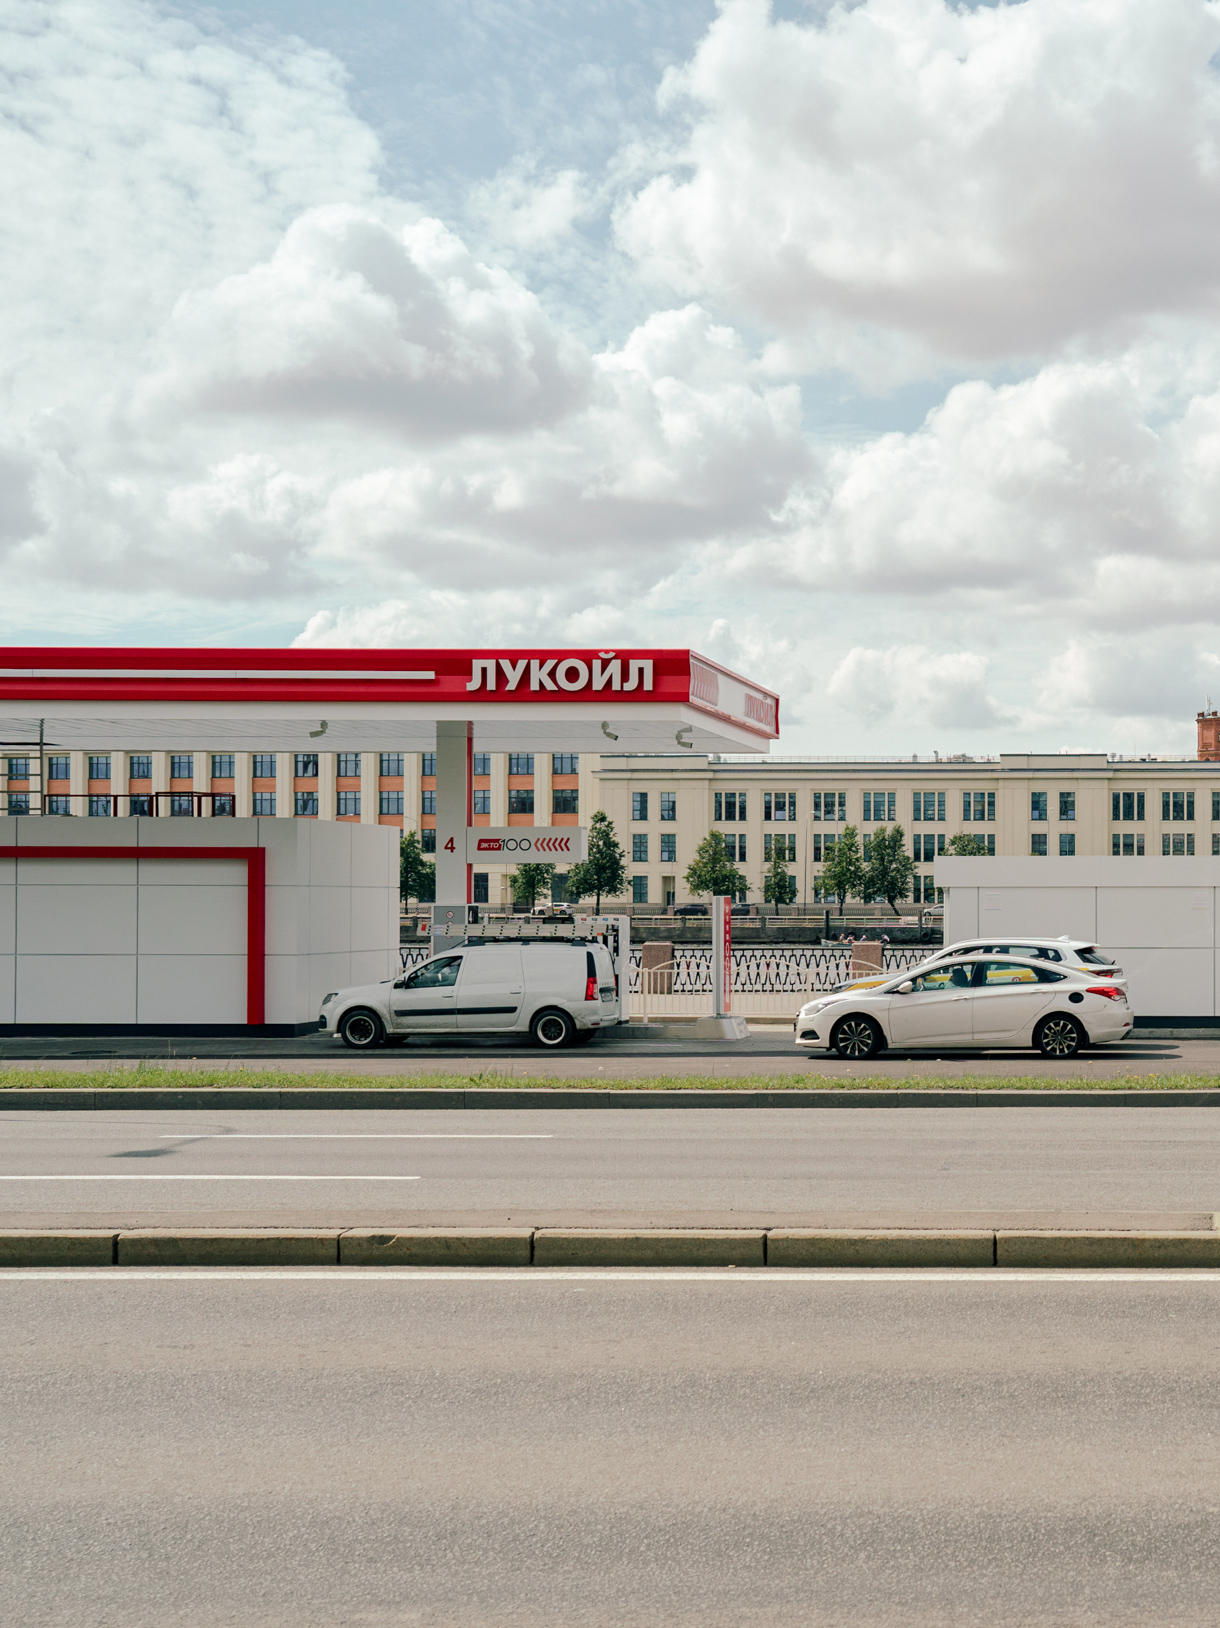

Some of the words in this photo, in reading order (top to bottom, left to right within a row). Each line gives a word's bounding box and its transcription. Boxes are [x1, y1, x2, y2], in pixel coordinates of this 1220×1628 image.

[466, 651, 654, 692] ЛУКОЙЛ
[444, 837, 455, 852] 4
[501, 838, 531, 851] 100
